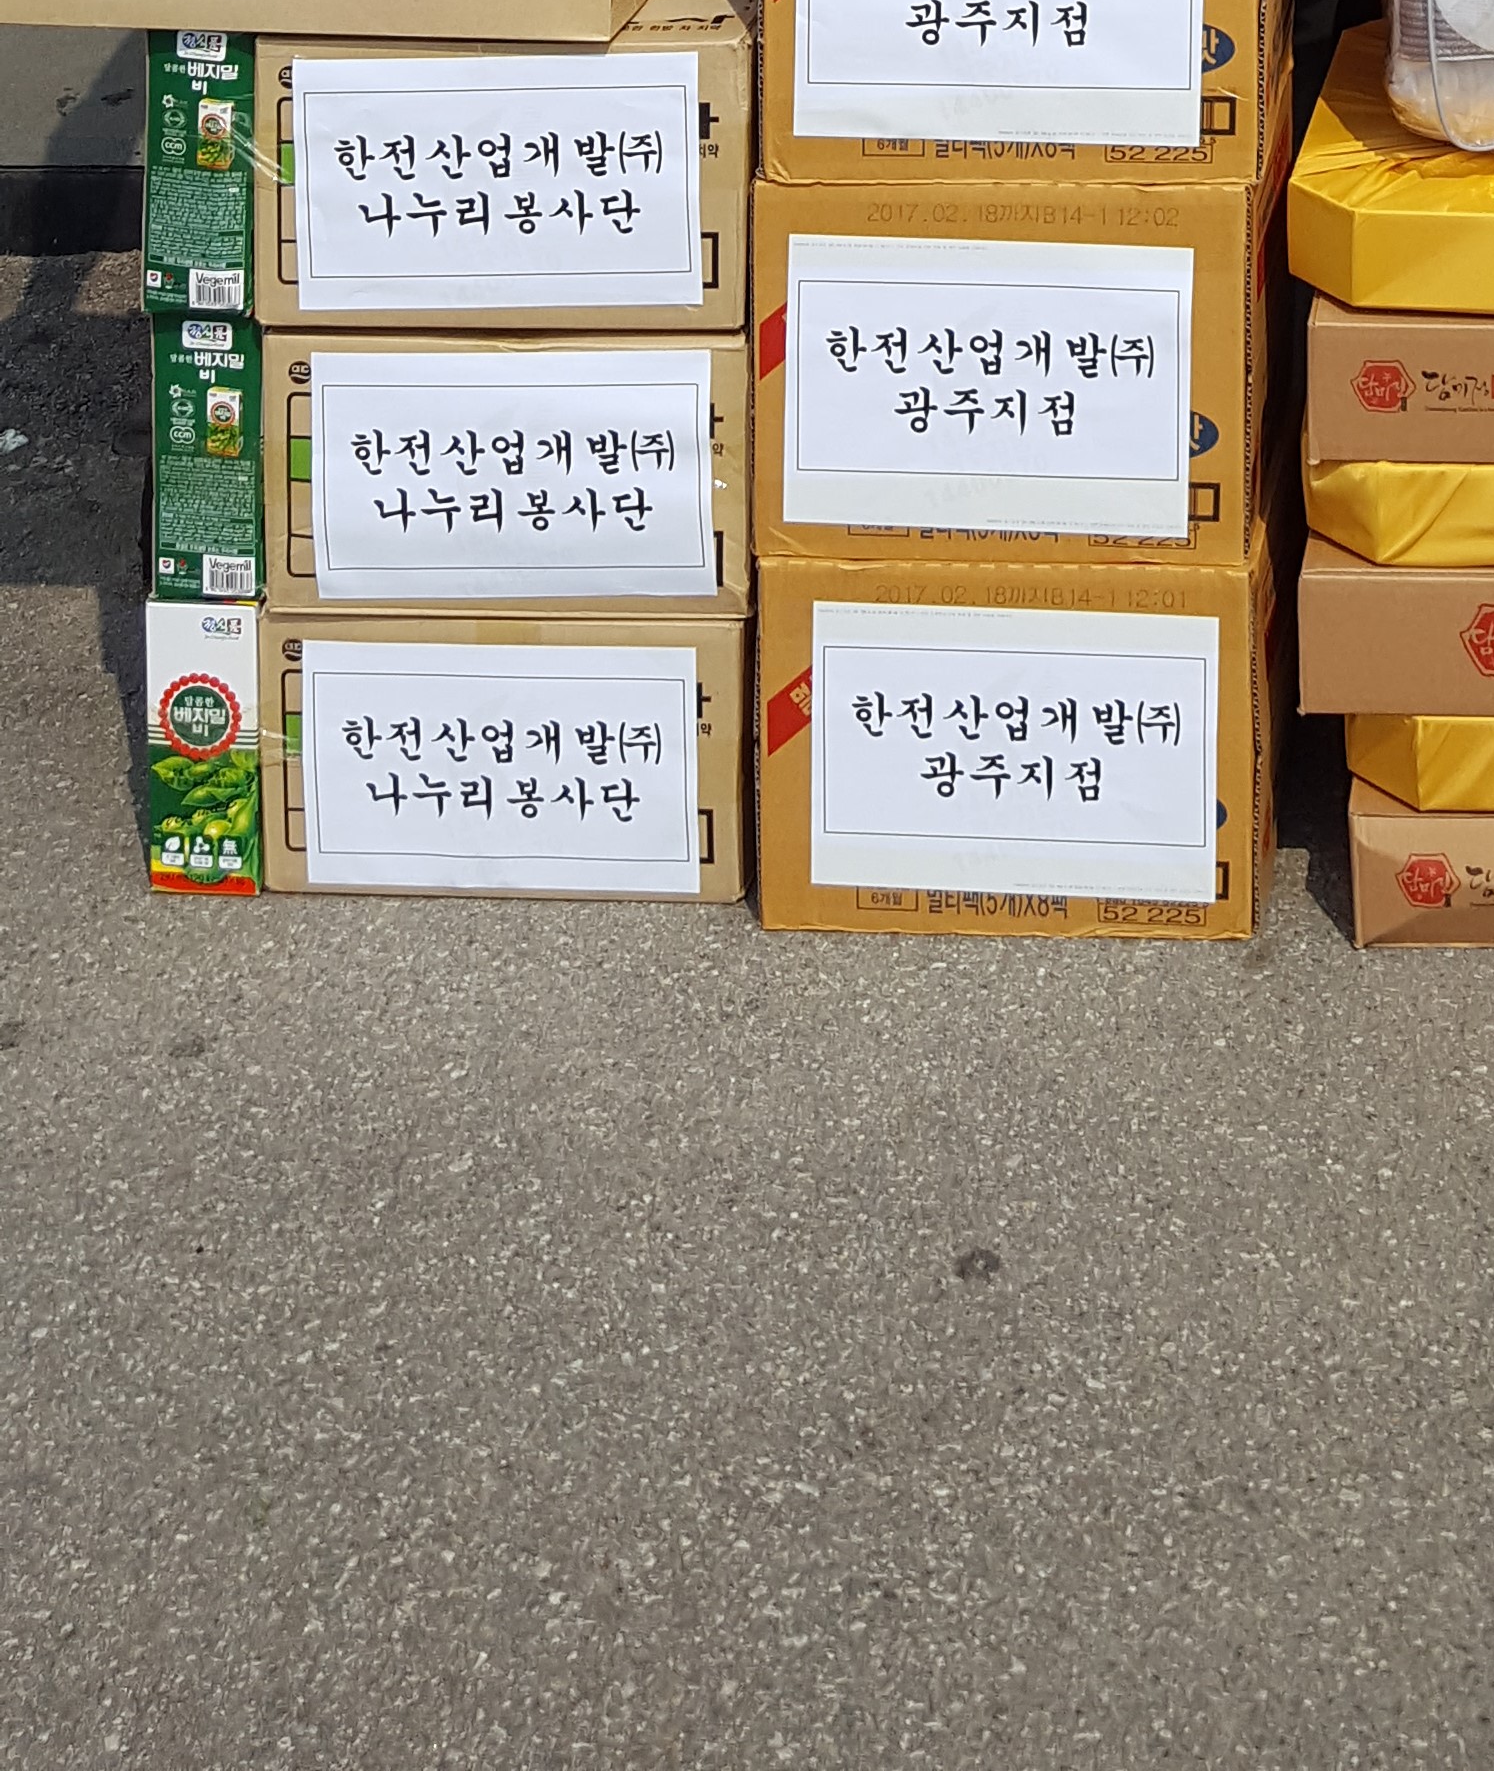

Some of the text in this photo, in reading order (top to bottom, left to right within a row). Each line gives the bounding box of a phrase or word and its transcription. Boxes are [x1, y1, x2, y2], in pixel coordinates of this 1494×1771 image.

[187, 61, 239, 81] 베지밀
[191, 80, 208, 95] 비
[332, 130, 664, 183] 한전산업개발(주)
[1109, 145, 1209, 164] 52 225
[357, 187, 643, 238] 나누리 봉사단
[195, 271, 240, 287] Vegemil
[194, 351, 245, 370] 베지밀
[825, 324, 1155, 379] 한전산업개발(주)
[199, 369, 216, 384] 비
[893, 386, 1077, 438] 광주지점
[349, 428, 676, 476] 한전산업개발(주)
[373, 485, 654, 535] 나누리 봉사단
[208, 556, 253, 576] Vegemil
[173, 706, 226, 725] 베지밀
[192, 724, 209, 737] 비
[851, 690, 1182, 747] 한전산업개발(주)
[340, 715, 664, 767] 한전산업개발(주)
[919, 751, 1103, 803] 광주지점
[366, 770, 642, 823] 나누리 봉사단
[1102, 905, 1203, 926] 52 225
